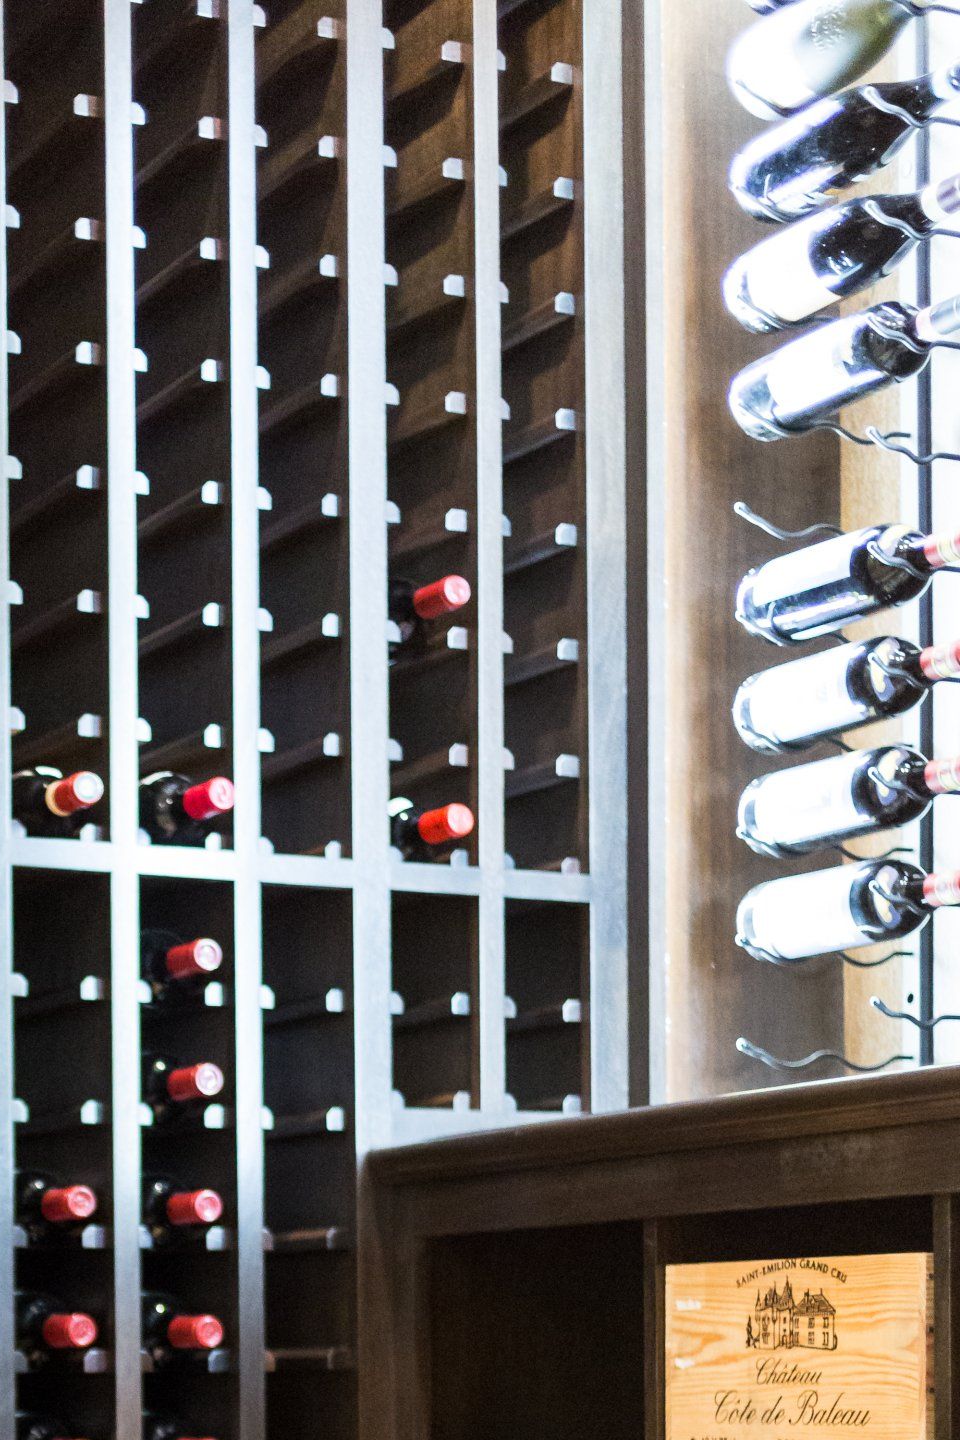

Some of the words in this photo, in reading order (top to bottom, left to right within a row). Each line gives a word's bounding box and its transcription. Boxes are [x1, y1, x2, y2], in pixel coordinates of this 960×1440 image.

[800, 1258, 828, 1274] GRAND
[831, 1267, 848, 1283] CRU
[756, 1357, 822, 1386] Château
[761, 1394, 786, 1424] de
[788, 1389, 872, 1426] Baleau
